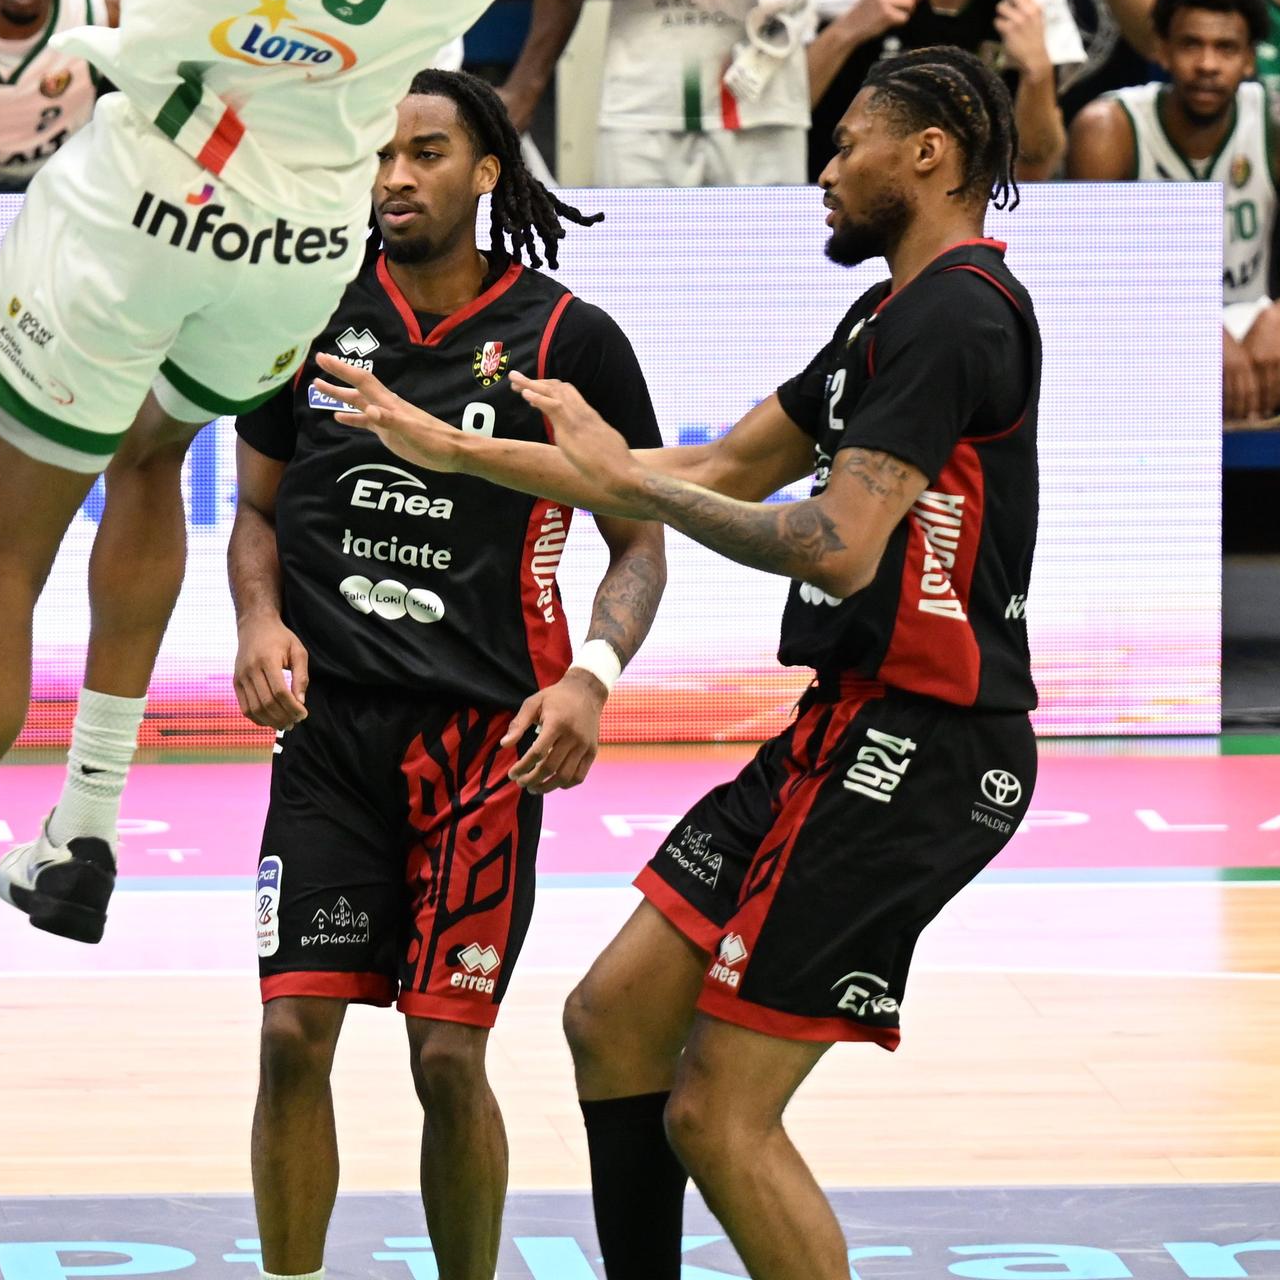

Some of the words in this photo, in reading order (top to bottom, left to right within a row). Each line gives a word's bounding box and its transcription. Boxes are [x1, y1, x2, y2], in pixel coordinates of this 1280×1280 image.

[241, 23, 333, 65] LOTTO
[473, 351, 508, 386] ASTORIA
[350, 478, 454, 520] Enea
[341, 528, 453, 570] łaciate
[343, 591, 367, 602] Fale
[375, 592, 402, 605] Loki
[412, 598, 438, 614] Koki
[843, 727, 918, 804] 1924
[970, 808, 1012, 835] WALDER
[301, 932, 369, 946] BYDGOSZCZ
[450, 971, 496, 994] errea
